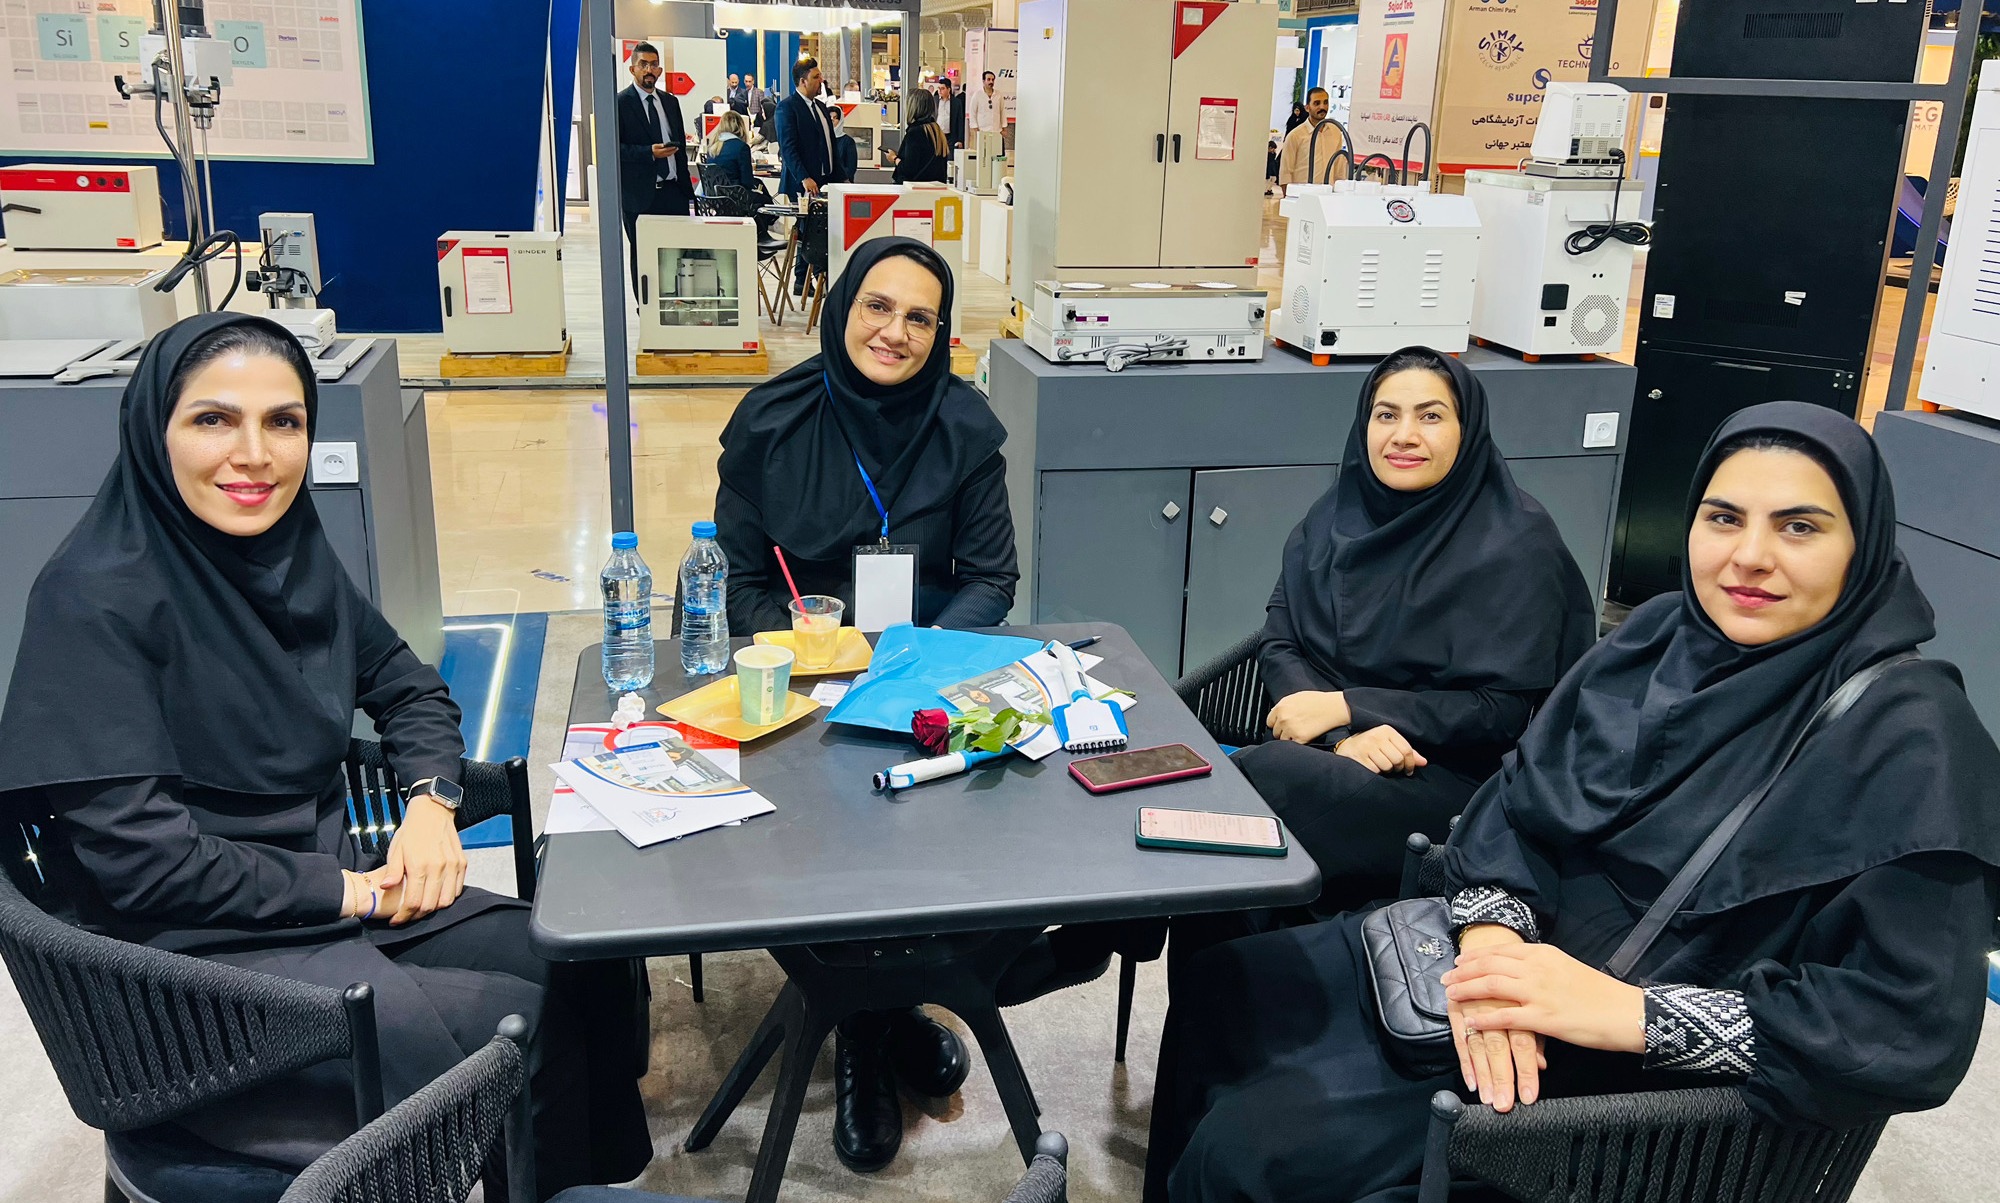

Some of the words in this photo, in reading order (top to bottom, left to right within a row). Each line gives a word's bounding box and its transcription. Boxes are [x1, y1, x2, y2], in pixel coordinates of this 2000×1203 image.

[1469, 5, 1487, 13] Arman
[56, 29, 73, 47] Si
[118, 31, 130, 48] S
[1478, 29, 1525, 53] SIMAX
[234, 36, 249, 53] O
[1558, 59, 1619, 70] TECHNO
[998, 68, 1017, 78] FIL
[1472, 114, 1525, 127] آزمایشگاهی
[1525, 116, 1538, 125] ات
[1485, 139, 1510, 150] جهانی
